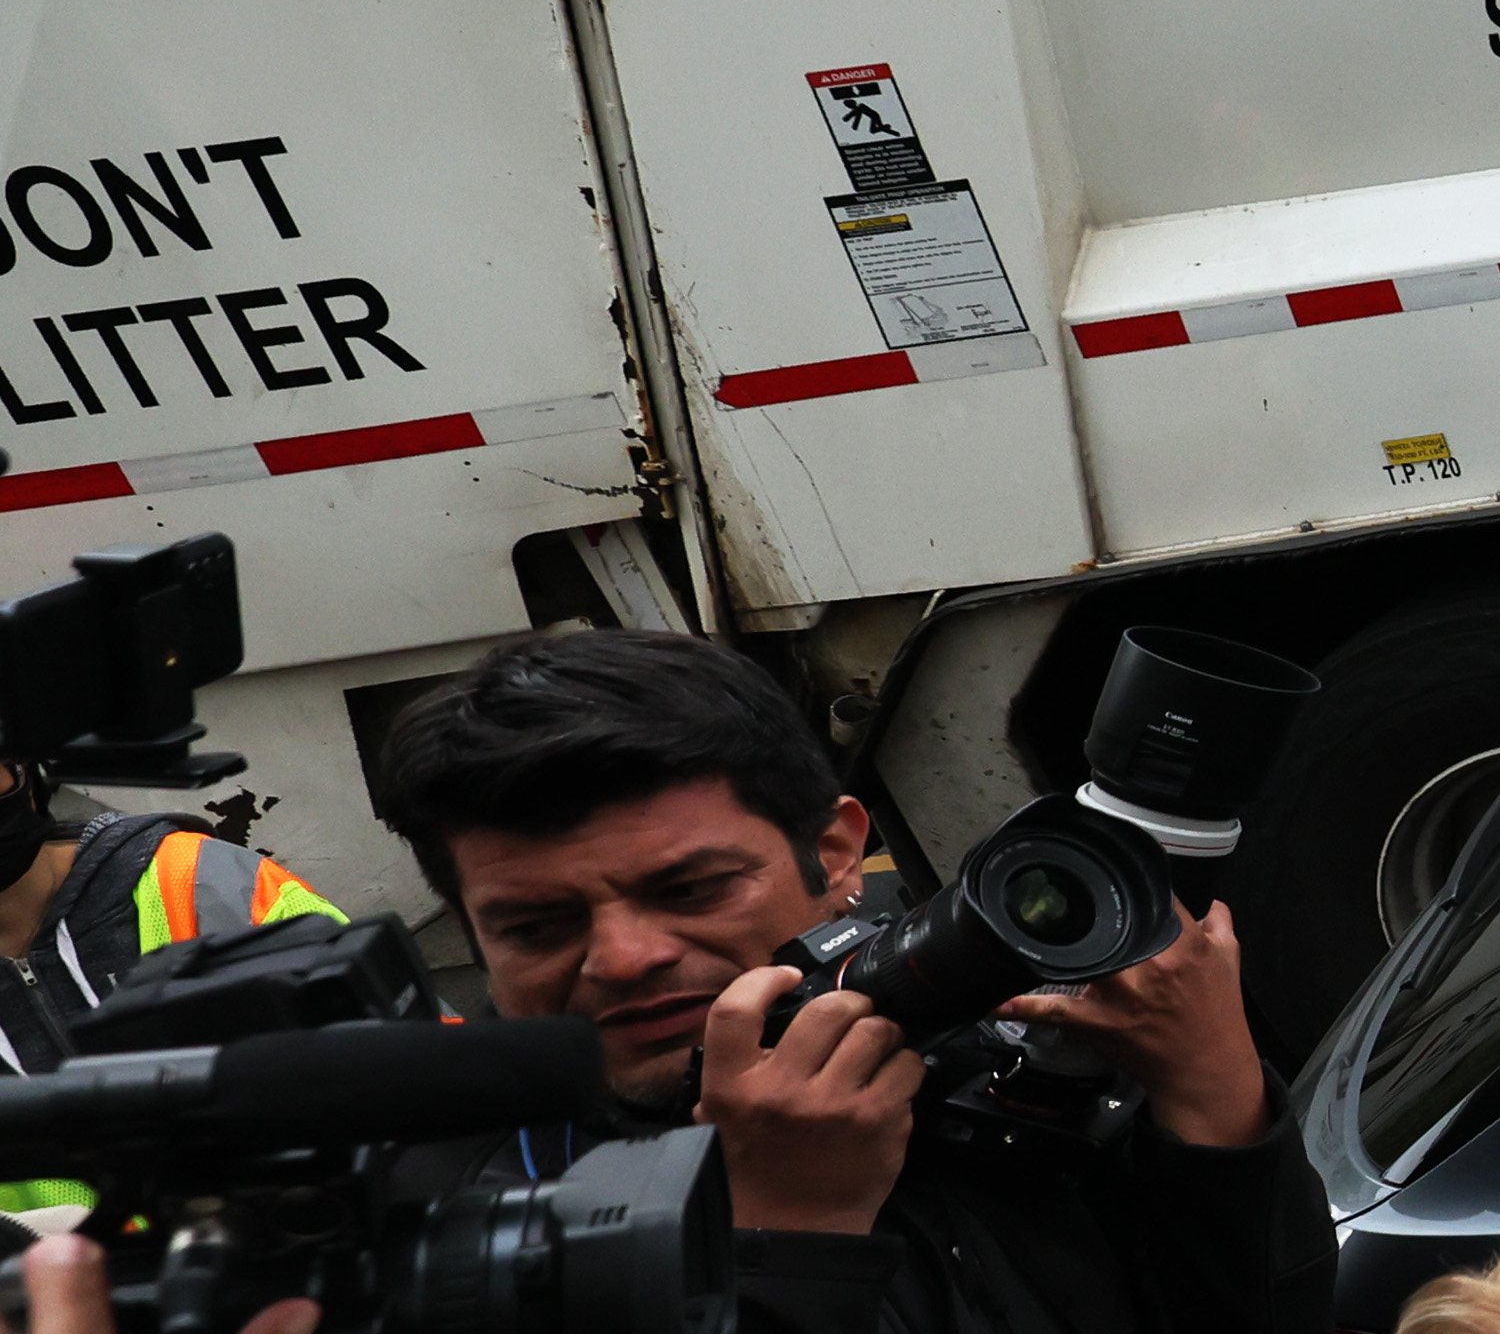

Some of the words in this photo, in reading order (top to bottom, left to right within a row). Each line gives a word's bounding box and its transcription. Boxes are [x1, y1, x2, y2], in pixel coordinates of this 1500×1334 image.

[0, 136, 302, 276] ON'T
[1382, 463, 1425, 485] T.P.
[1427, 457, 1461, 480] 120
[820, 925, 859, 952] SONY
